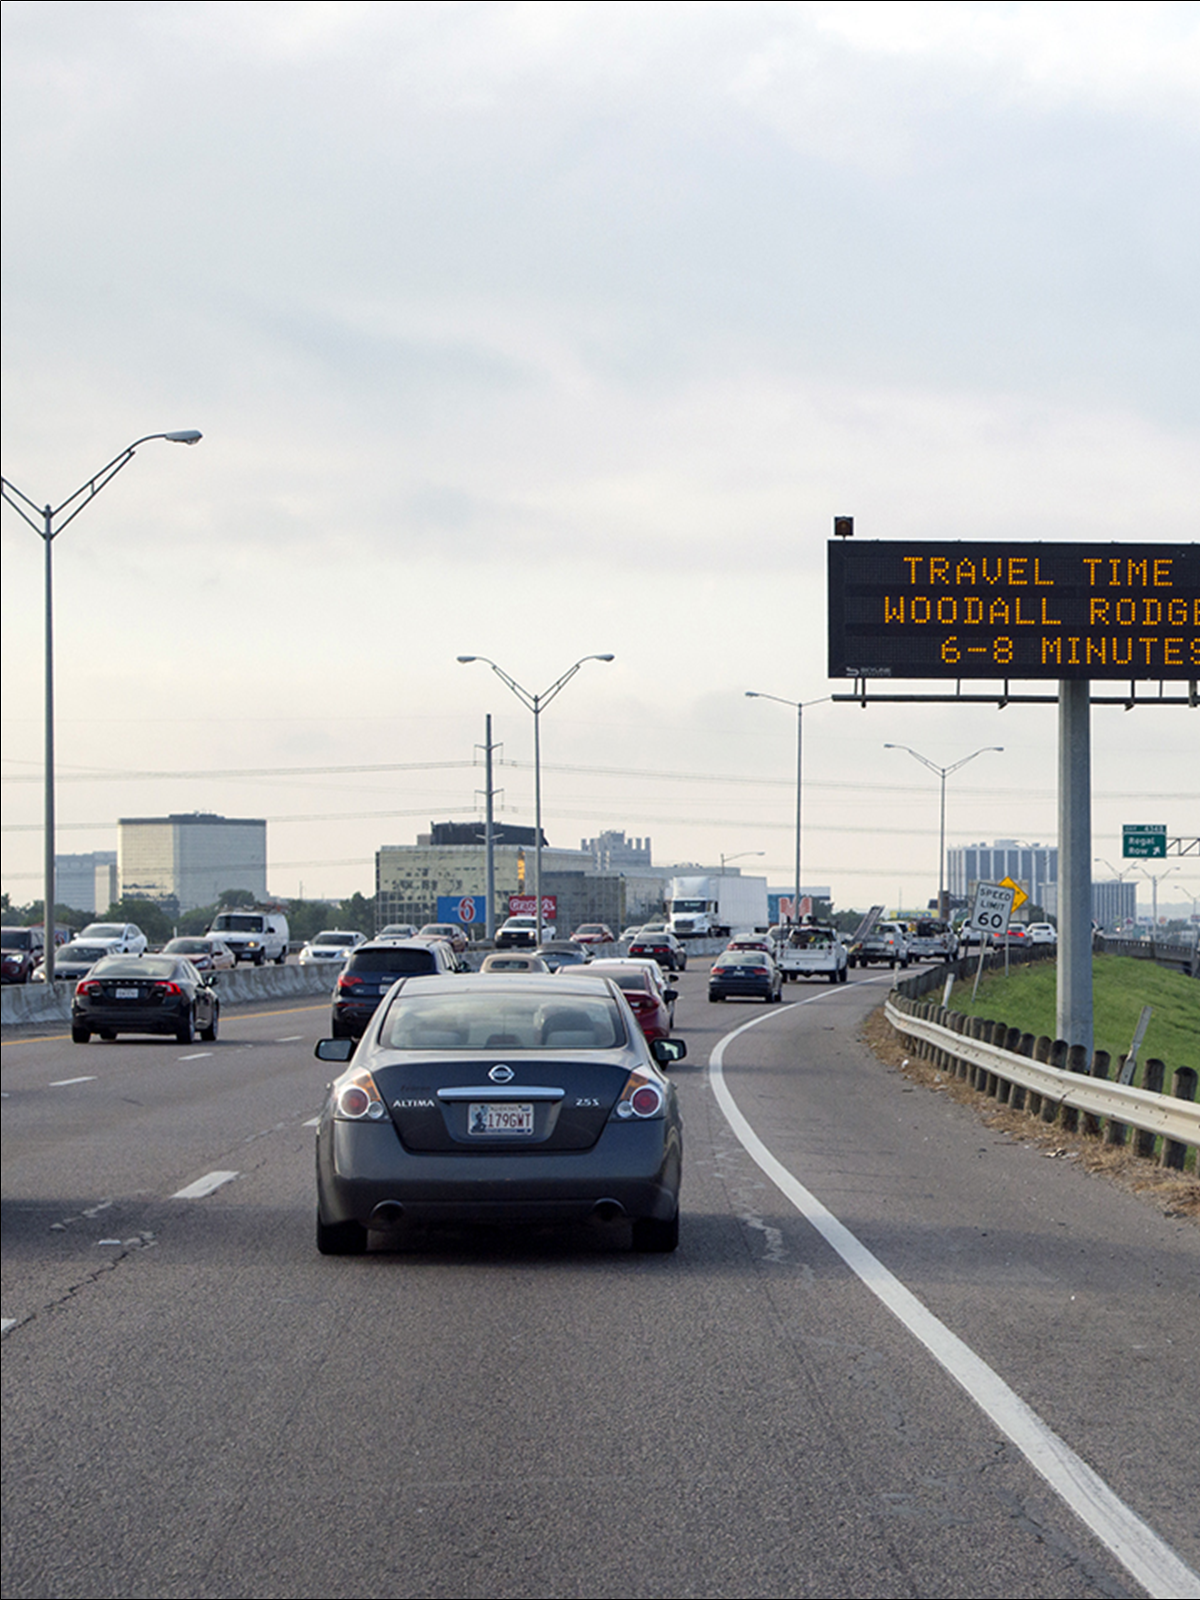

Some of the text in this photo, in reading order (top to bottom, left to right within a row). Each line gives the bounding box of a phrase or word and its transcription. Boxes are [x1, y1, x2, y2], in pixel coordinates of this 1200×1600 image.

[903, 556, 1054, 586] TRAVEL
[1083, 558, 1173, 586] TIME
[884, 596, 1061, 625] WOODALL
[941, 636, 1013, 664] 6-8
[1128, 837, 1155, 846] Regal
[1128, 847, 1148, 855] Row
[980, 888, 1011, 901] SPEED
[459, 897, 476, 922] 6
[980, 900, 1005, 911] LIMIT
[977, 912, 1003, 928] 60
[393, 1099, 435, 1108] ALTIMA
[488, 1113, 531, 1128] 179GWT
